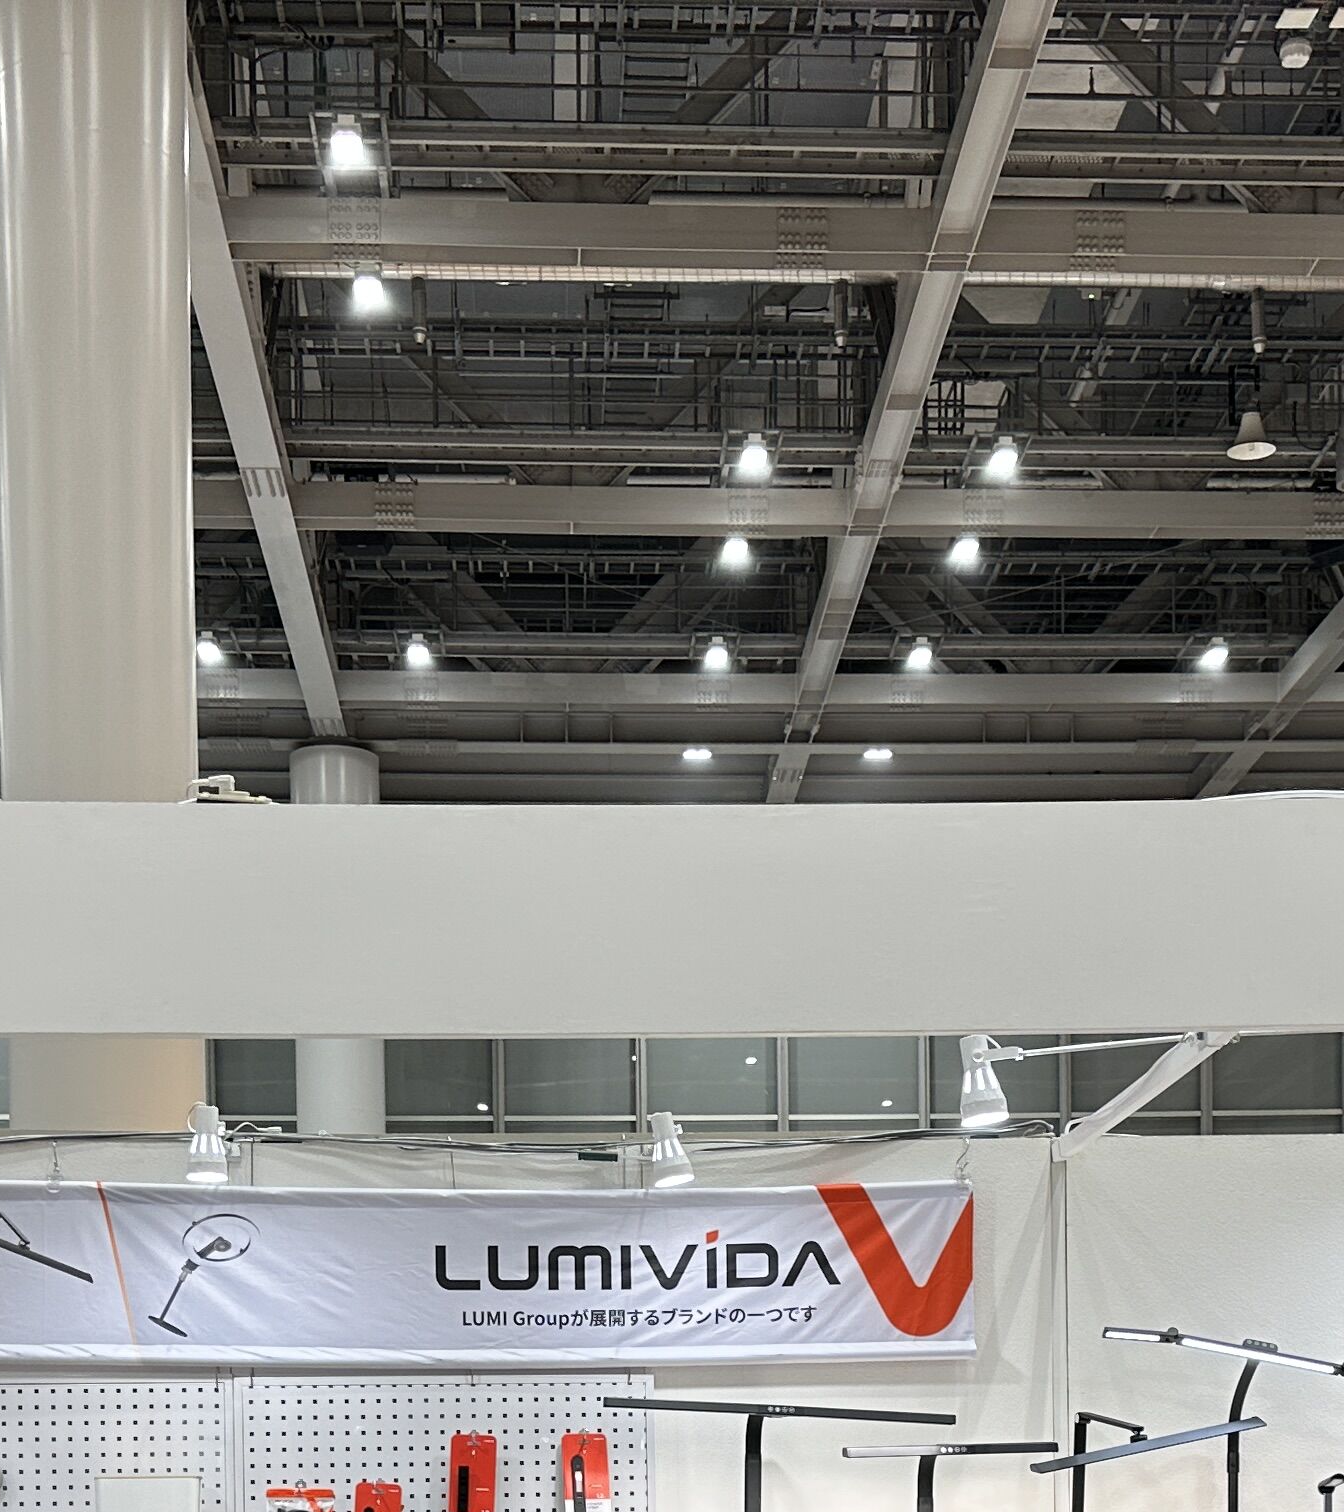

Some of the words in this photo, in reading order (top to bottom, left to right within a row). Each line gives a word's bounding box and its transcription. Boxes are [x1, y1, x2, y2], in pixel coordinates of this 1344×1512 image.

[462, 1310, 508, 1327] LUMI
[513, 1305, 817, 1330] Groupが展開するブランドの一つです
